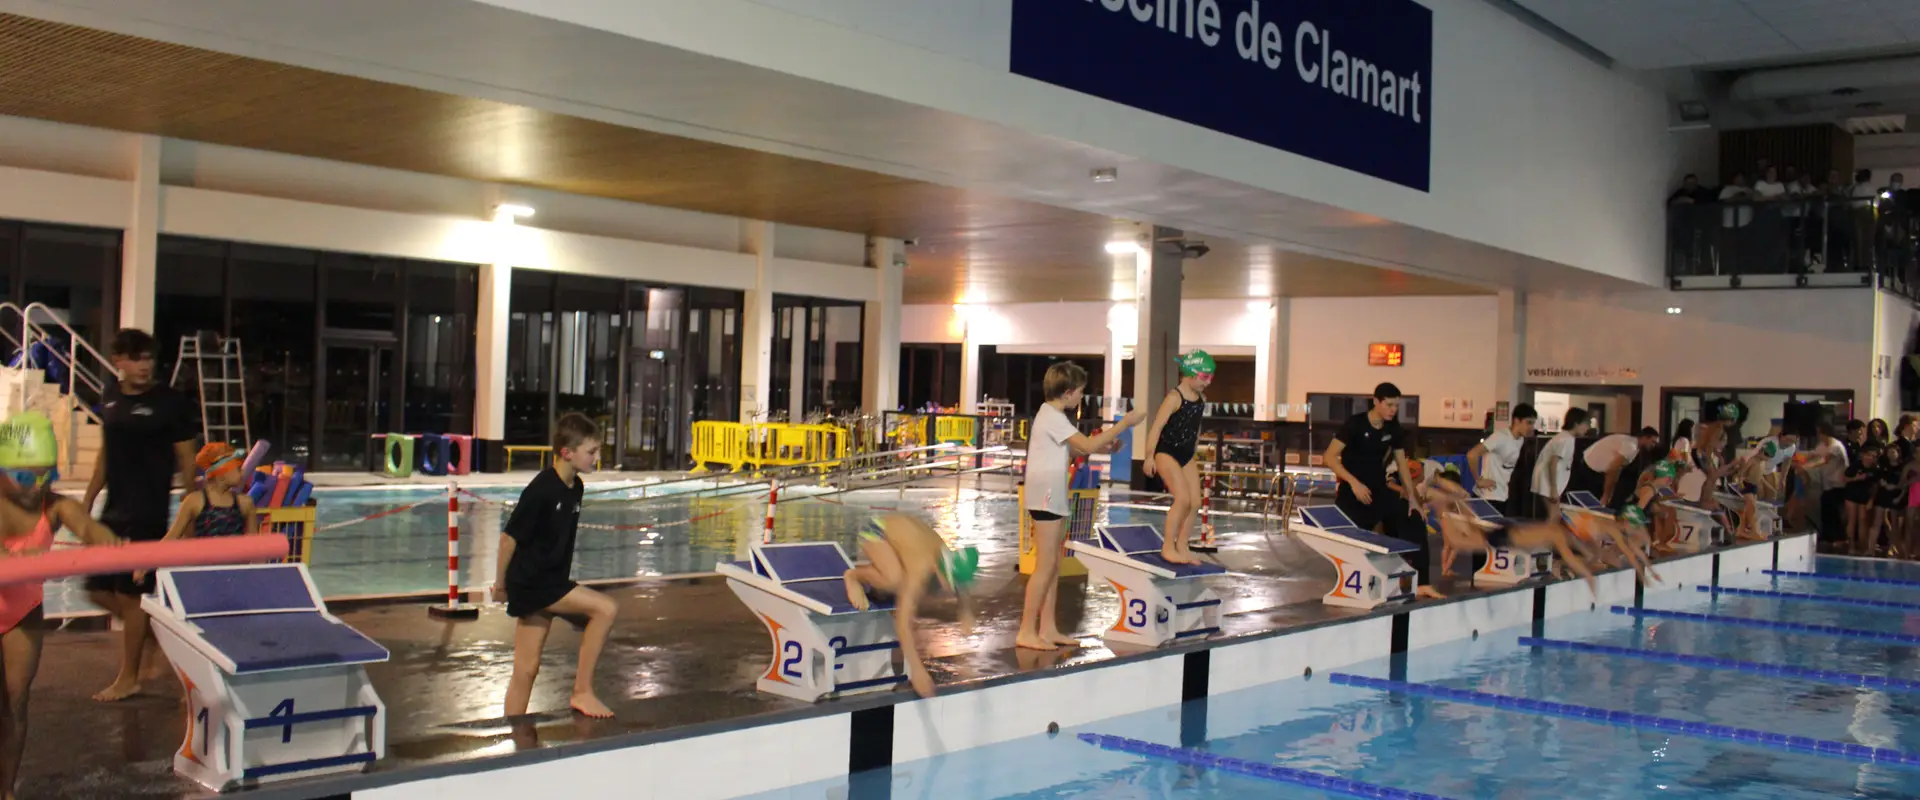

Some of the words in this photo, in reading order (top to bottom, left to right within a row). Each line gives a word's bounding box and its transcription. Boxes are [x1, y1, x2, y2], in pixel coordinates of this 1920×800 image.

[1235, 0, 1282, 70] de
[1295, 20, 1421, 123] Clamart
[1527, 365, 1581, 377] vestiaires
[1682, 526, 1694, 541] 7
[1495, 550, 1508, 570] 5
[1344, 570, 1362, 594] 4
[1128, 598, 1147, 627] 3
[783, 640, 802, 678] 2
[198, 707, 209, 756] 1
